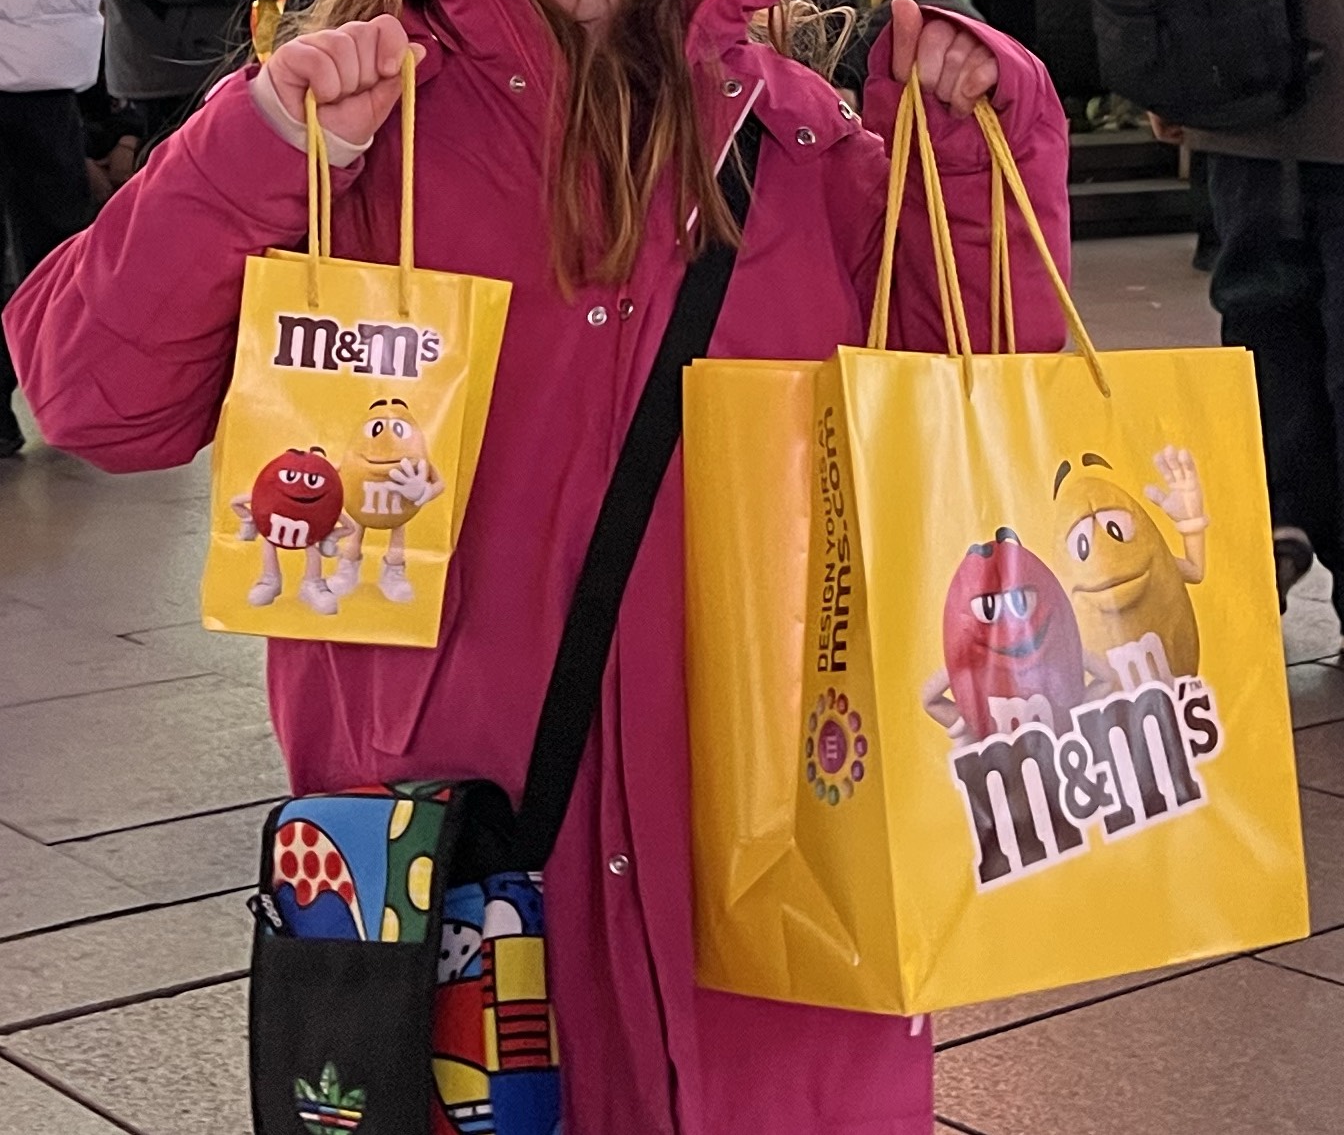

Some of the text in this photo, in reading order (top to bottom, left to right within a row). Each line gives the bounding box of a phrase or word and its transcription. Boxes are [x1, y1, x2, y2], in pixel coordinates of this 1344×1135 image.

[266, 513, 310, 548] m
[819, 456, 837, 555] YOURS
[823, 406, 853, 673] mms.com
[817, 562, 837, 673] DESIGN
